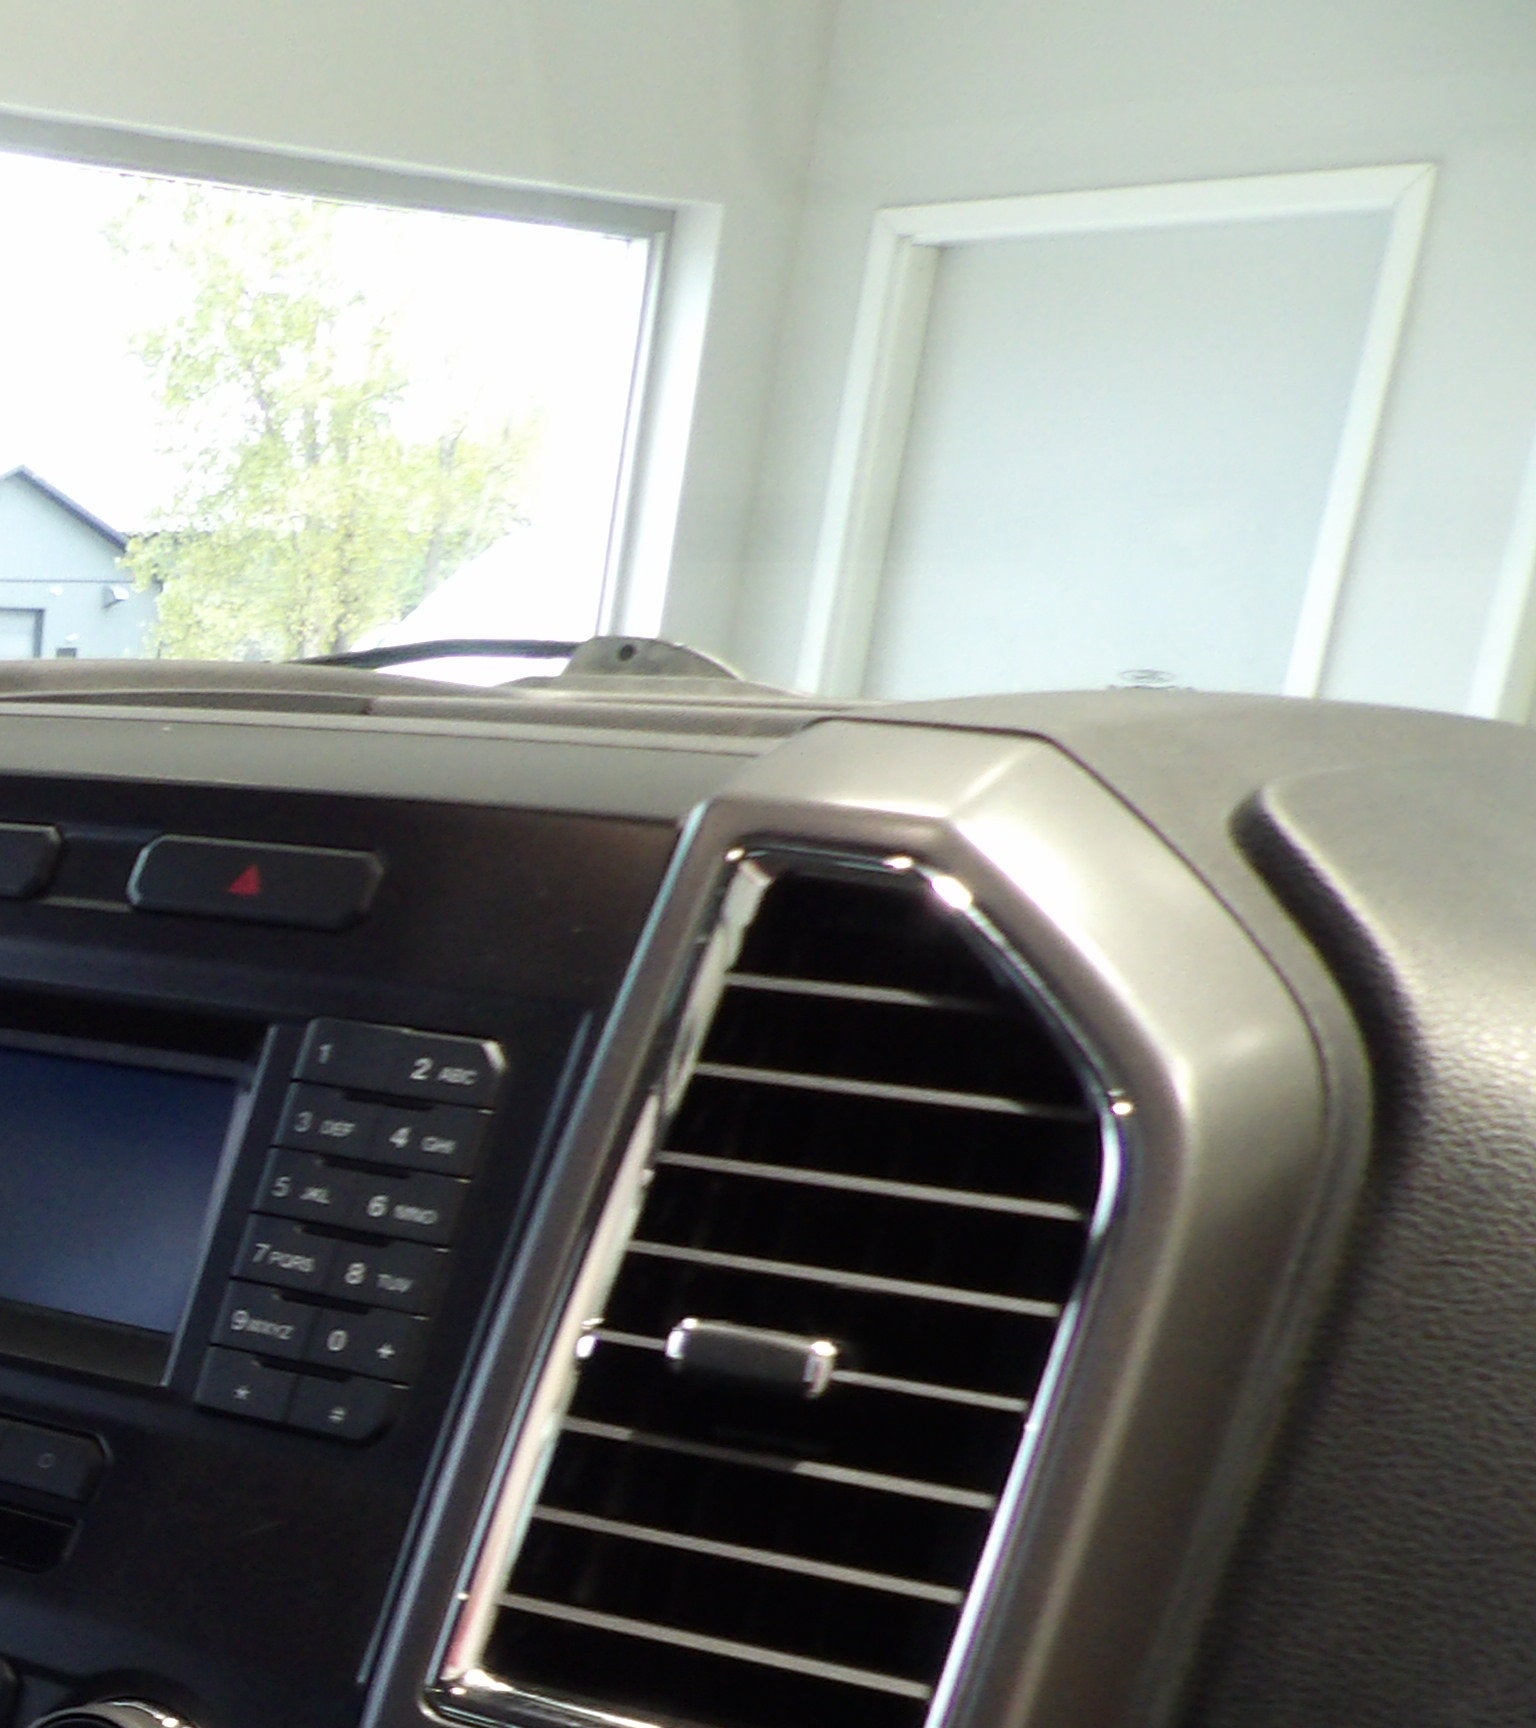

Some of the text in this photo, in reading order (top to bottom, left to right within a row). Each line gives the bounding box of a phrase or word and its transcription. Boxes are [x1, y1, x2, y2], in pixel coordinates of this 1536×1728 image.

[409, 1057, 434, 1080] 2
[294, 1111, 314, 1133] 3
[389, 1126, 412, 1149] 4
[272, 1176, 292, 1198] 5
[367, 1195, 390, 1218] 6
[252, 1243, 273, 1264] 7
[344, 1262, 368, 1286] 8
[230, 1310, 251, 1332] 9
[326, 1329, 349, 1353] 0
